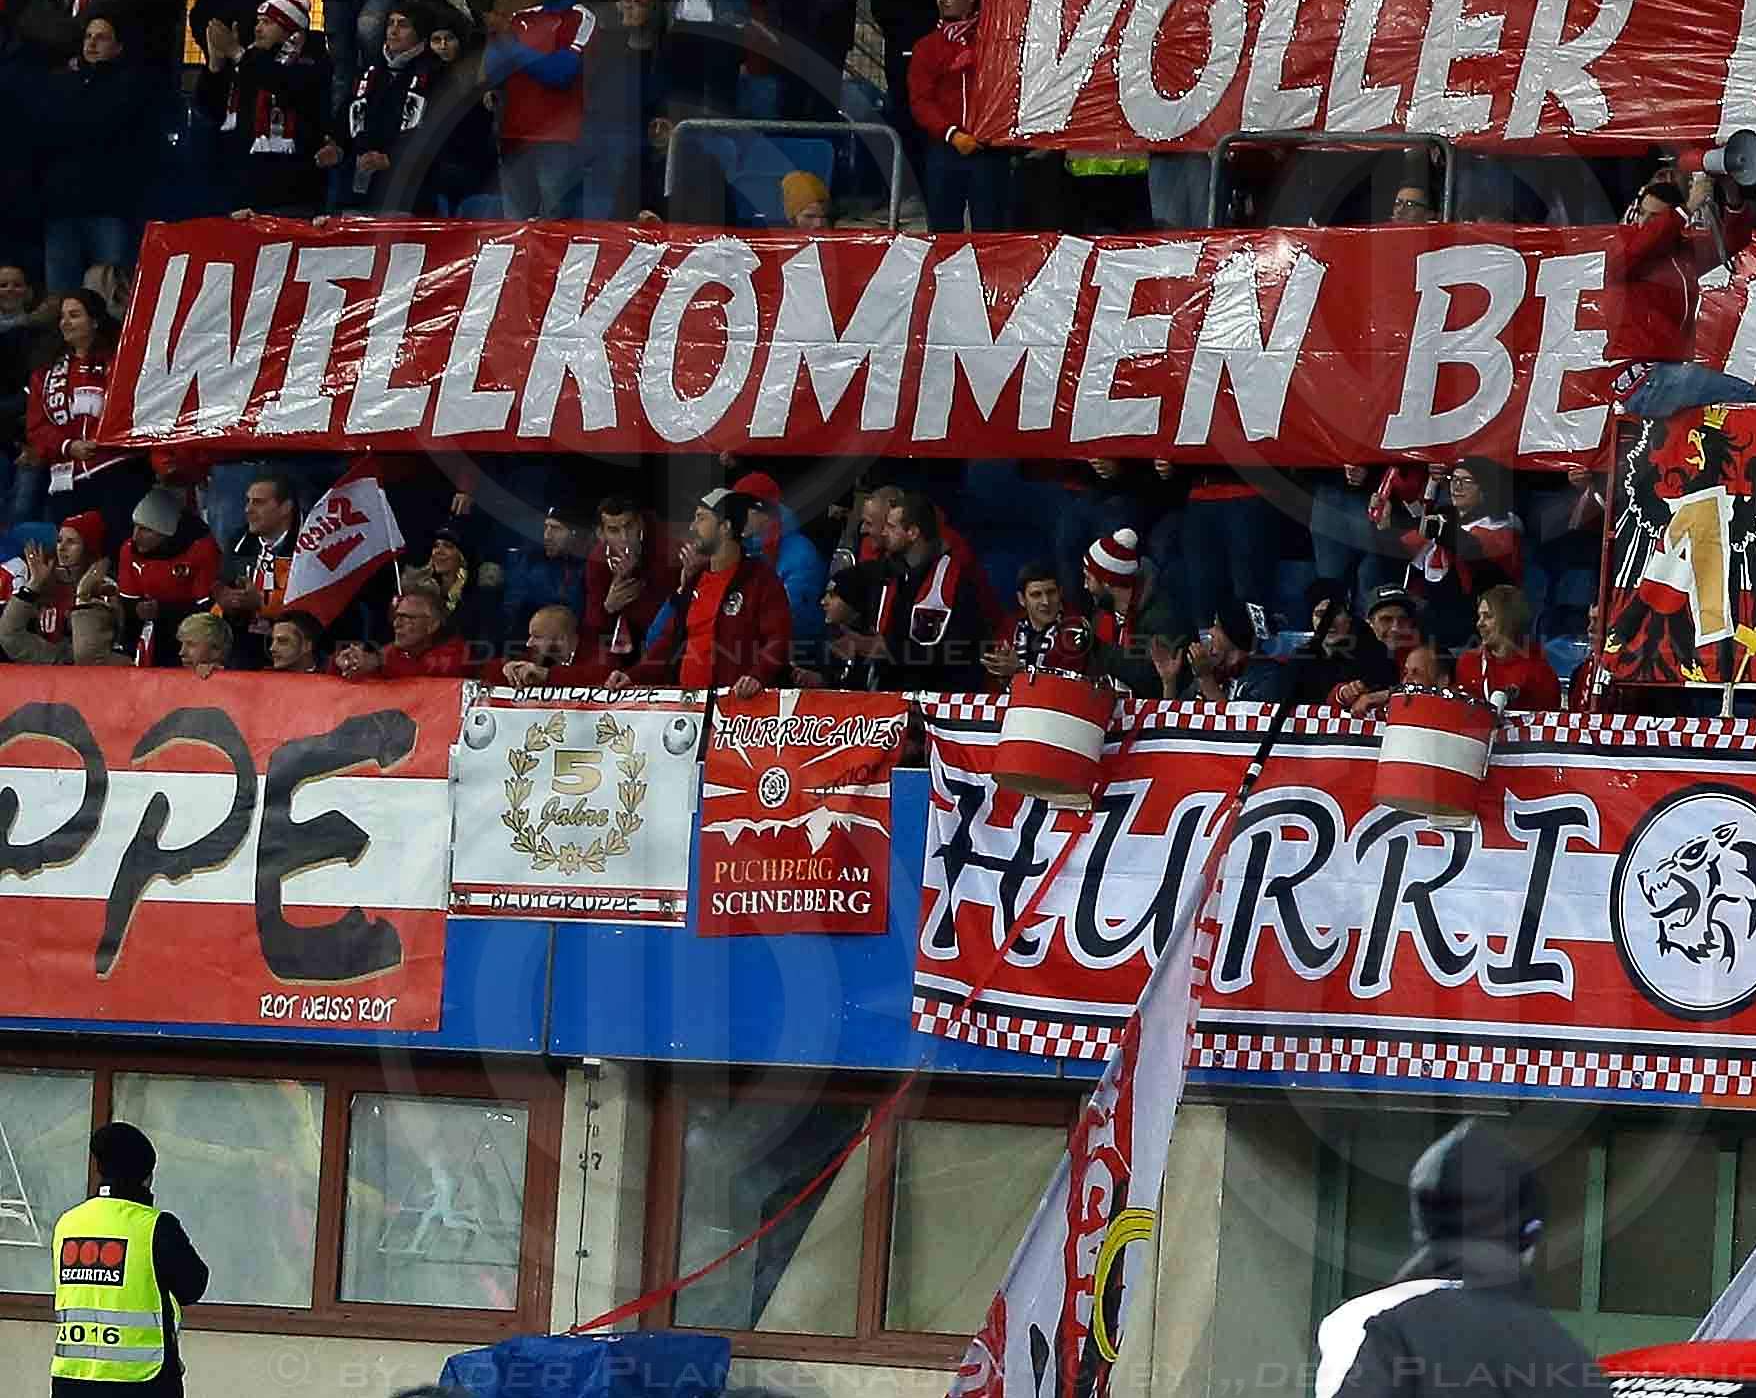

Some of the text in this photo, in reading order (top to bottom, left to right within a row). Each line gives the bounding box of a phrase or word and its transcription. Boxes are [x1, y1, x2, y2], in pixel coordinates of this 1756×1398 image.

[130, 235, 1328, 448] WILLKOMMEN
[714, 712, 905, 749] HURRICANES
[552, 750, 605, 795] 5
[537, 796, 610, 836] Jahre
[714, 857, 870, 884] PUCHBERG AM
[922, 765, 1601, 1003] HURRI
[711, 889, 872, 915] SCHNEEBERG
[259, 993, 397, 1024] ROT WEISS ROT
[61, 1268, 121, 1283] SECURITAS
